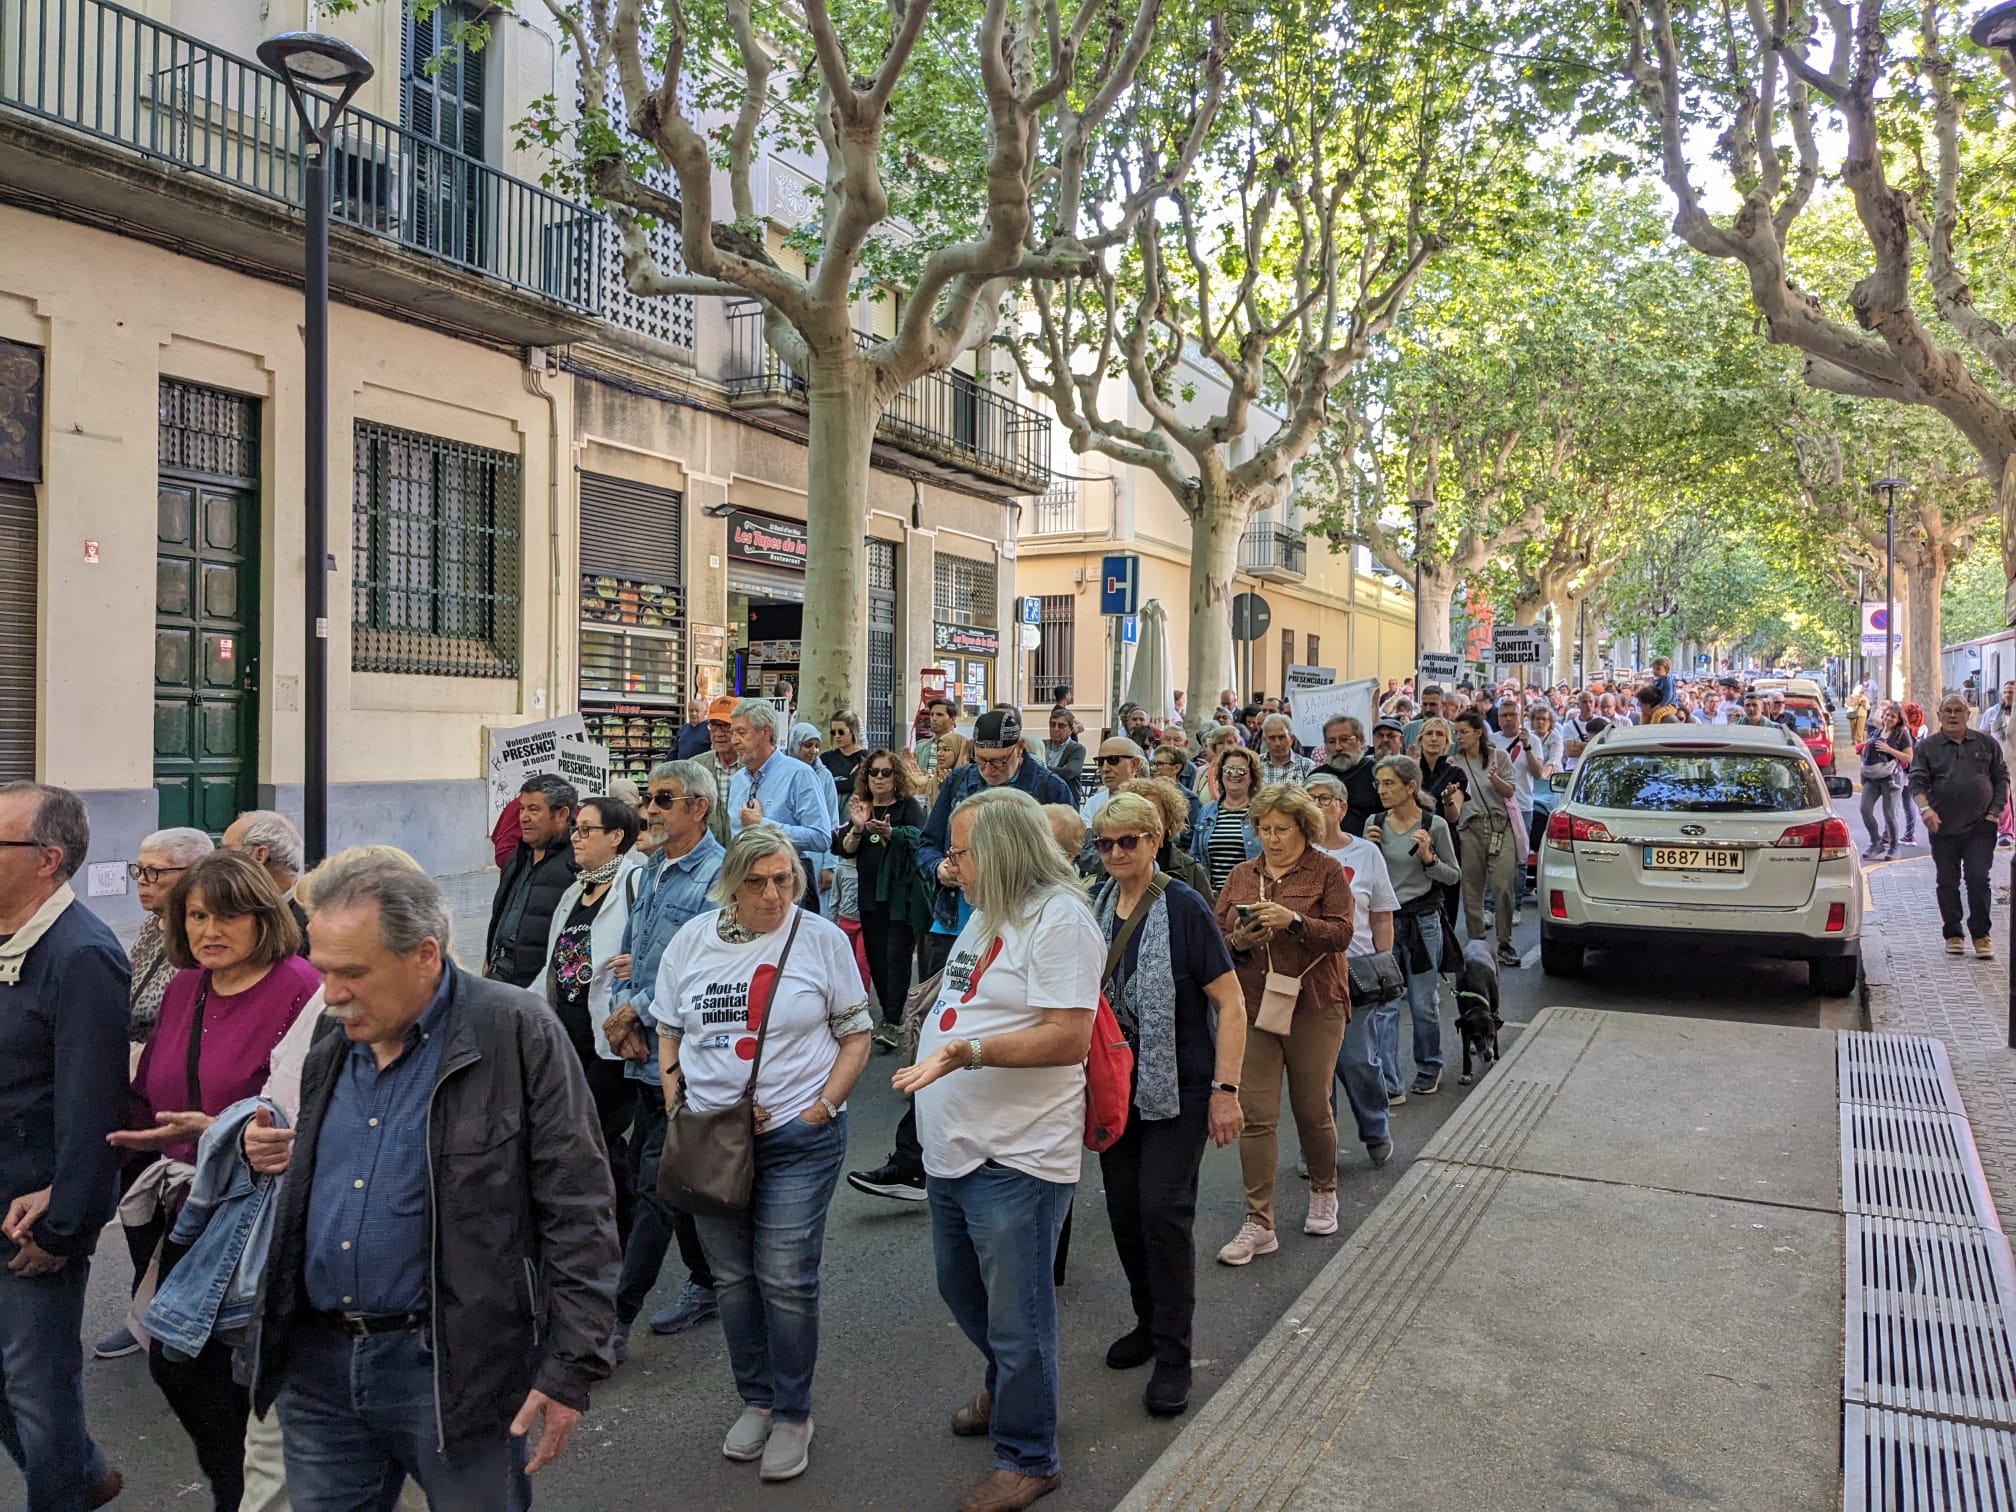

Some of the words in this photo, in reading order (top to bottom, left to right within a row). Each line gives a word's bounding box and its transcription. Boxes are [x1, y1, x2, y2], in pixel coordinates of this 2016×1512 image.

[734, 526, 753, 544] Les
[782, 538, 796, 552] de
[1495, 641, 1532, 652] SANITAT
[1423, 654, 1459, 663] potenciem
[505, 737, 530, 748] Volem
[531, 730, 557, 742] visites
[522, 758, 530, 767] al
[531, 752, 556, 765] nostre
[561, 750, 576, 760] Volem
[576, 753, 592, 763] visites
[558, 759, 601, 780] PRESENCIALS
[574, 776, 589, 786] nostre
[1656, 850, 1699, 865] 8687
[1706, 852, 1739, 867] HBW
[705, 982, 748, 996] Mou-te
[691, 994, 704, 1003] per
[702, 994, 747, 1010] sanitat
[694, 1002, 701, 1010] la
[702, 1009, 749, 1025] pública
